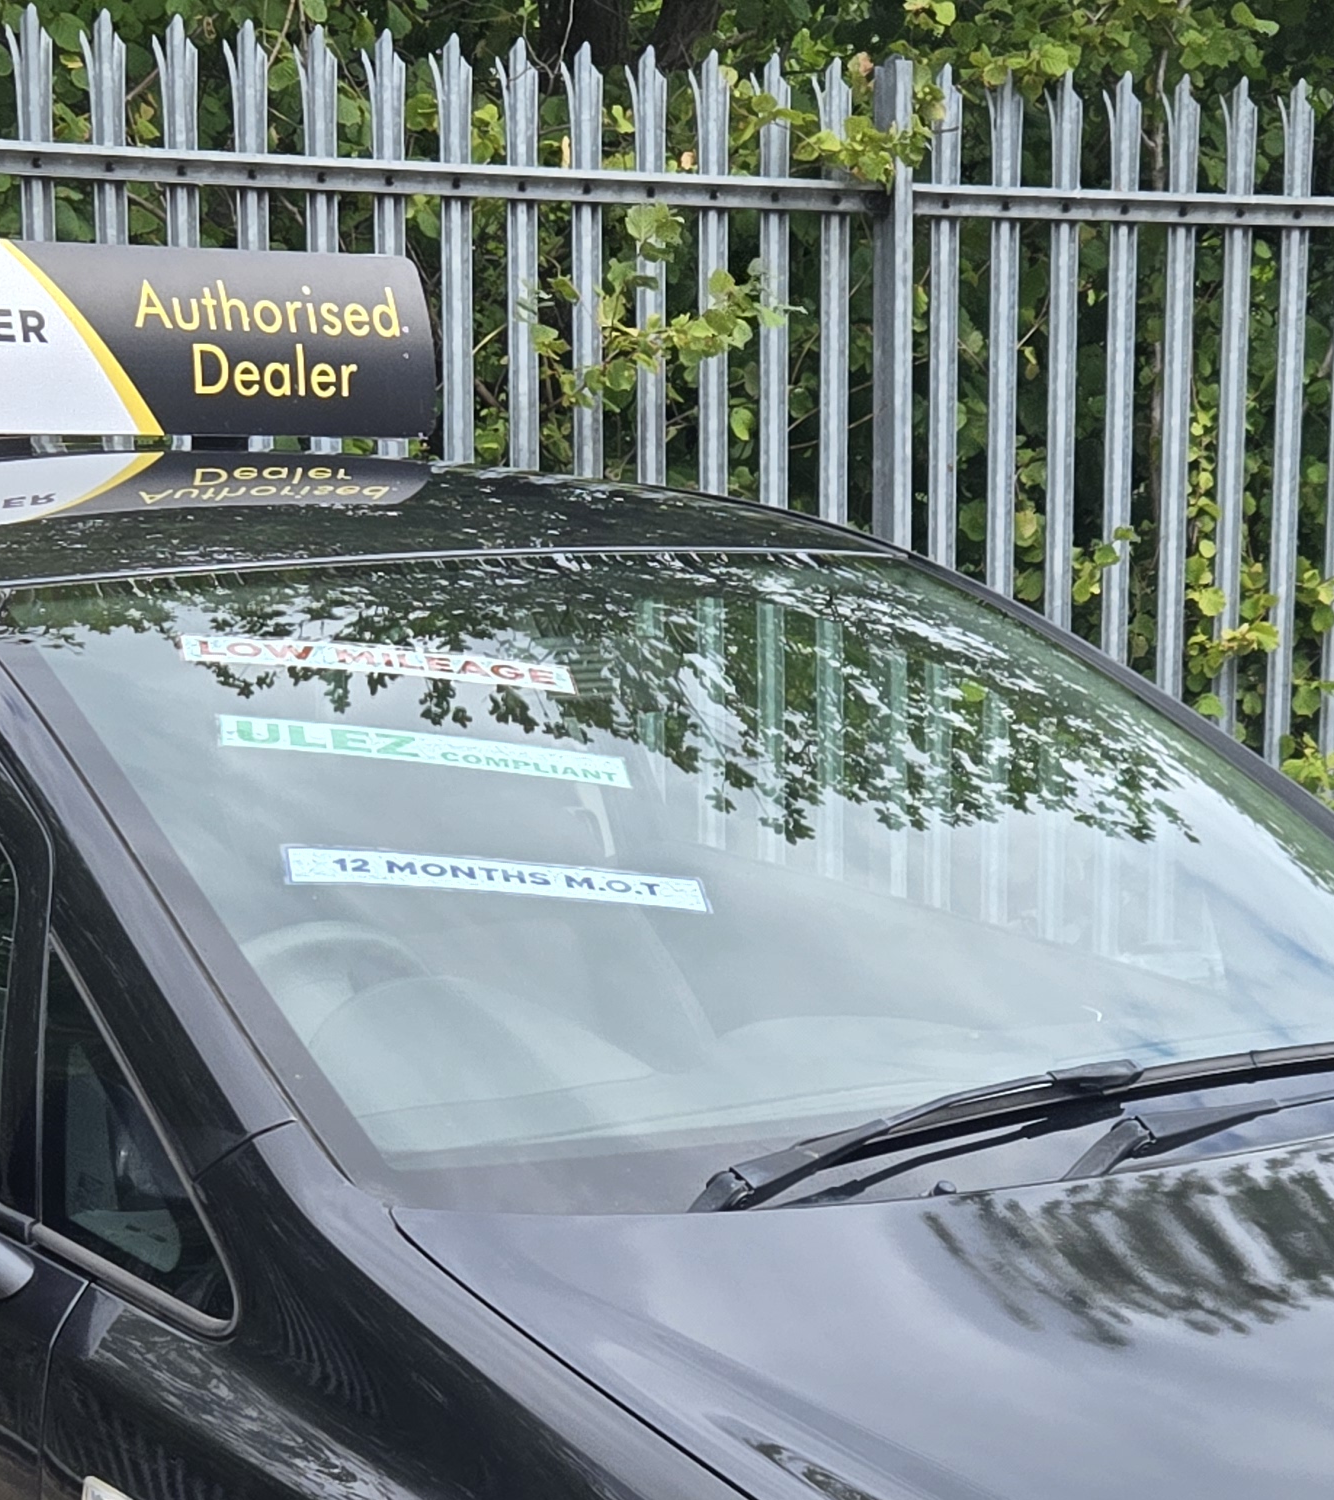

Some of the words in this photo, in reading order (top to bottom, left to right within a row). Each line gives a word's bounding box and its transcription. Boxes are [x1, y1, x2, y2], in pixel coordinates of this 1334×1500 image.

[135, 279, 400, 337] Authorised
[192, 343, 358, 398] Dealer
[198, 640, 314, 660] LOW
[335, 648, 558, 684] MILEAGE
[236, 720, 420, 757] ULEZ
[441, 751, 617, 783] COMPLIANT
[333, 858, 370, 873] 12
[386, 860, 551, 886] MONTHS
[565, 874, 660, 897] M.O.T
